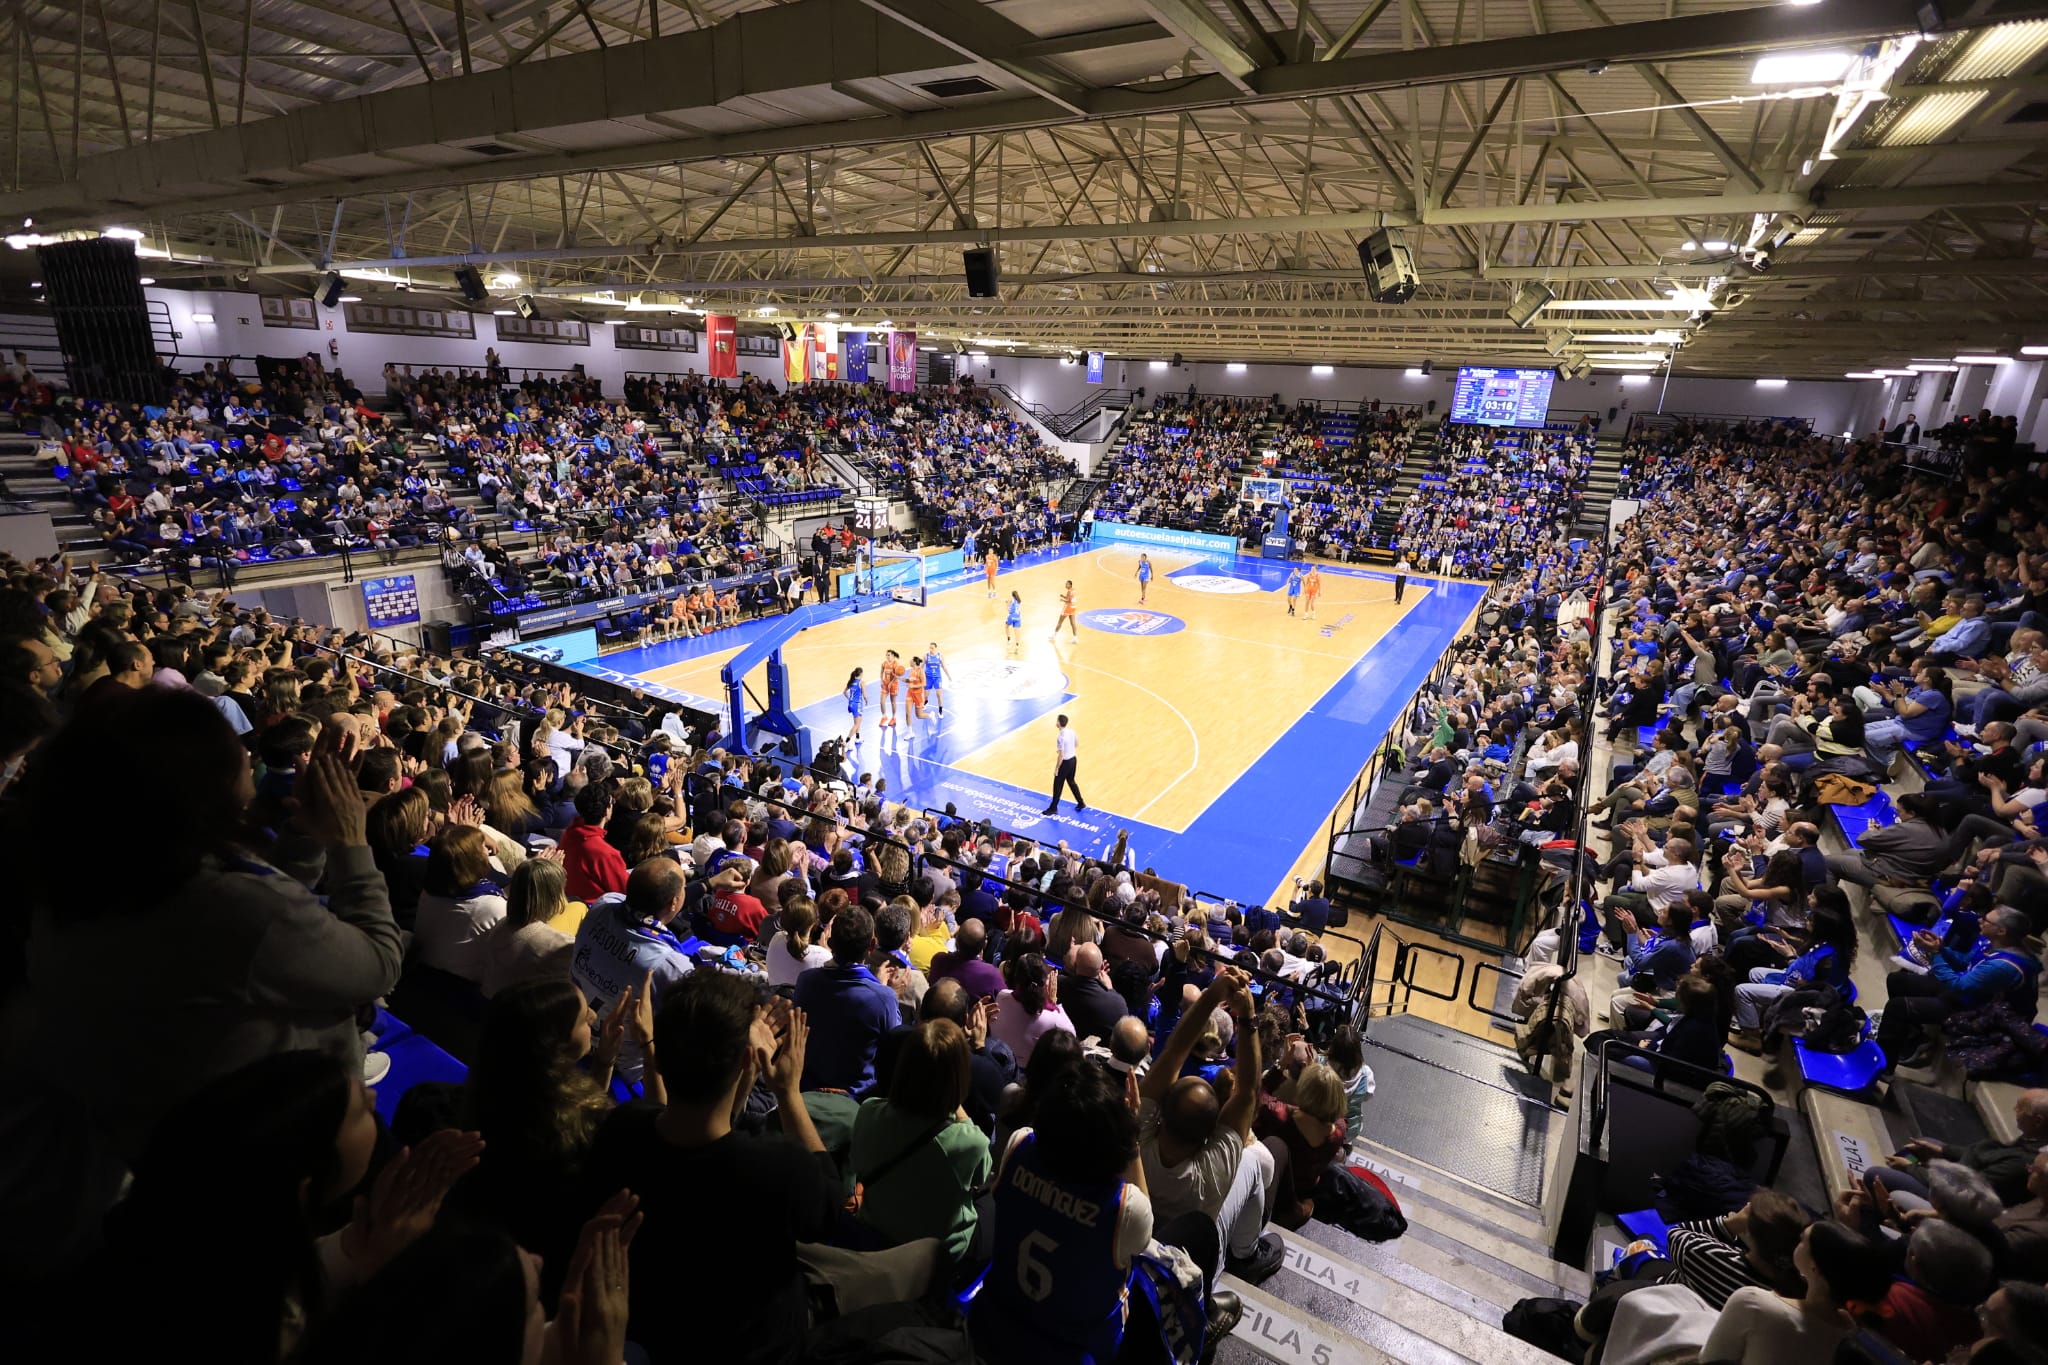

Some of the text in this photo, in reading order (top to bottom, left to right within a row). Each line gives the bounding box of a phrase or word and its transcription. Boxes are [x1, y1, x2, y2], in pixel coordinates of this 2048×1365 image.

[1485, 401, 1513, 410] 03:18
[855, 514, 871, 529] 24
[874, 514, 888, 530] 24
[1114, 528, 1230, 549] autoescuelaselpilar.com
[596, 598, 625, 608] SALAMANCA
[1840, 1135, 1866, 1174] FILA 2
[1397, 1175, 1405, 1184] 1
[1016, 1229, 1061, 1302] 6
[1284, 1246, 1360, 1296] FILA 4
[1311, 1343, 1333, 1365] 5
